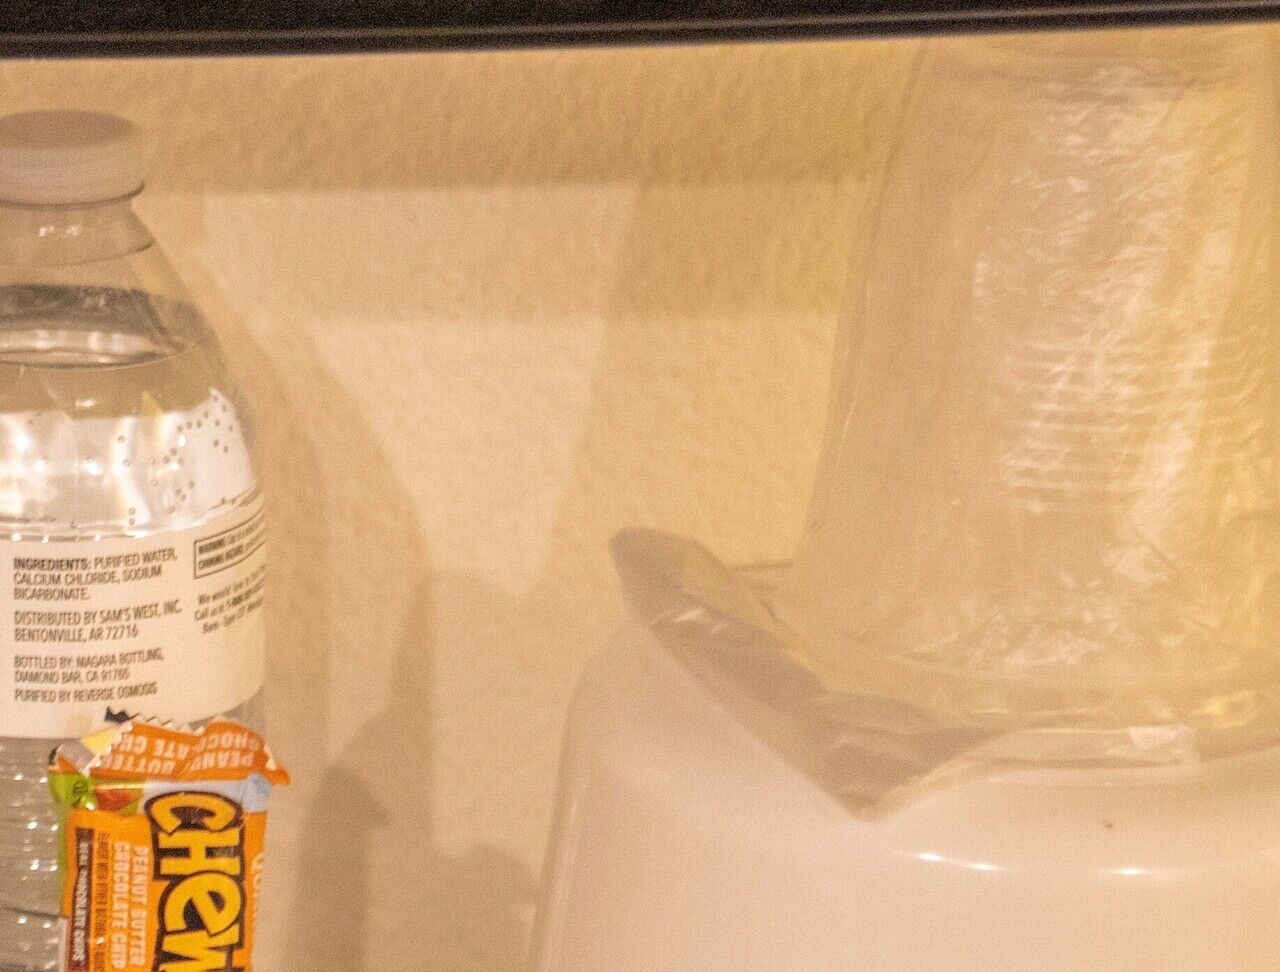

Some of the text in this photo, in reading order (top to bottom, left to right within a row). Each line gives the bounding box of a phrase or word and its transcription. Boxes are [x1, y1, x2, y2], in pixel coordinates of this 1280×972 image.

[13, 547, 178, 571] INGREDIENTS: PURIFIED WATER,
[13, 565, 162, 586] CALCIUM CHLORIDE, SODIUM
[13, 587, 90, 601] BICARBONATE.
[14, 611, 82, 625] DISTRIBUTED
[83, 610, 98, 625] BY
[99, 607, 131, 623] SAM'S
[133, 603, 162, 620] WEST,
[14, 624, 139, 643] BENTONVILLE, AR 72716
[14, 655, 57, 669] BOTTLED
[76, 654, 117, 668] NIAGARA
[14, 670, 60, 684] DIAMOND
[62, 670, 84, 684] BAR,
[86, 670, 99, 682] CA
[14, 681, 158, 703] PURIFIED BY REVERSE OSMOSIS
[75, 867, 89, 928] CHOCOLATE
[111, 841, 131, 970] CHOCOLATE CHIP
[130, 846, 149, 966] PEANUT BUTTER
[72, 929, 85, 962] CHIPS
